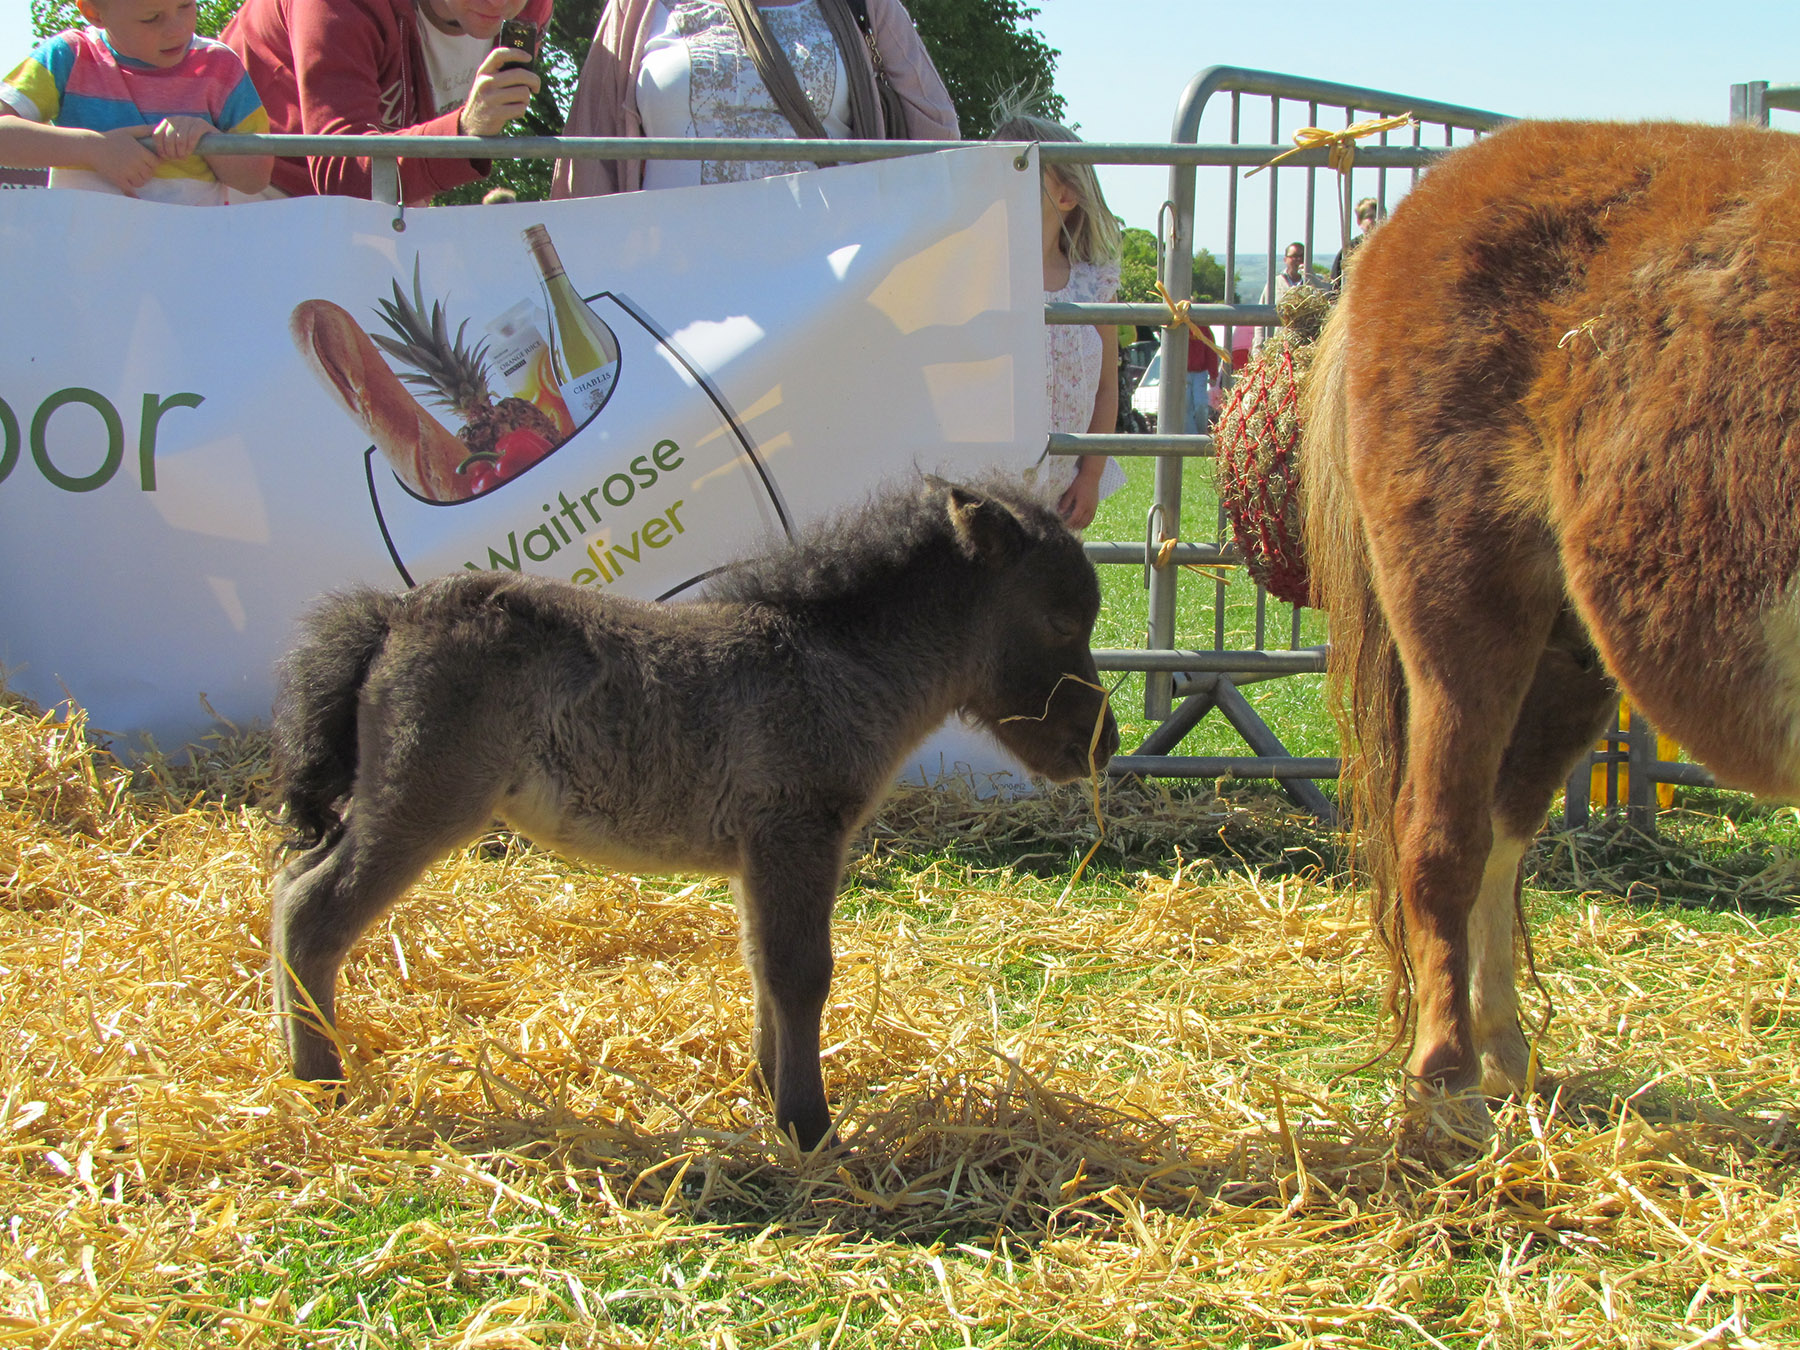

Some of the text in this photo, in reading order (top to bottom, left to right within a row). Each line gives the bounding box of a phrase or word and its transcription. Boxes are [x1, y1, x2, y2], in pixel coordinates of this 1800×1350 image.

[500, 351, 525, 371] ORANGE
[524, 340, 542, 355] JUICE
[573, 372, 612, 395] CHABLIS
[0, 387, 207, 493] or
[463, 439, 685, 573] Waitrose
